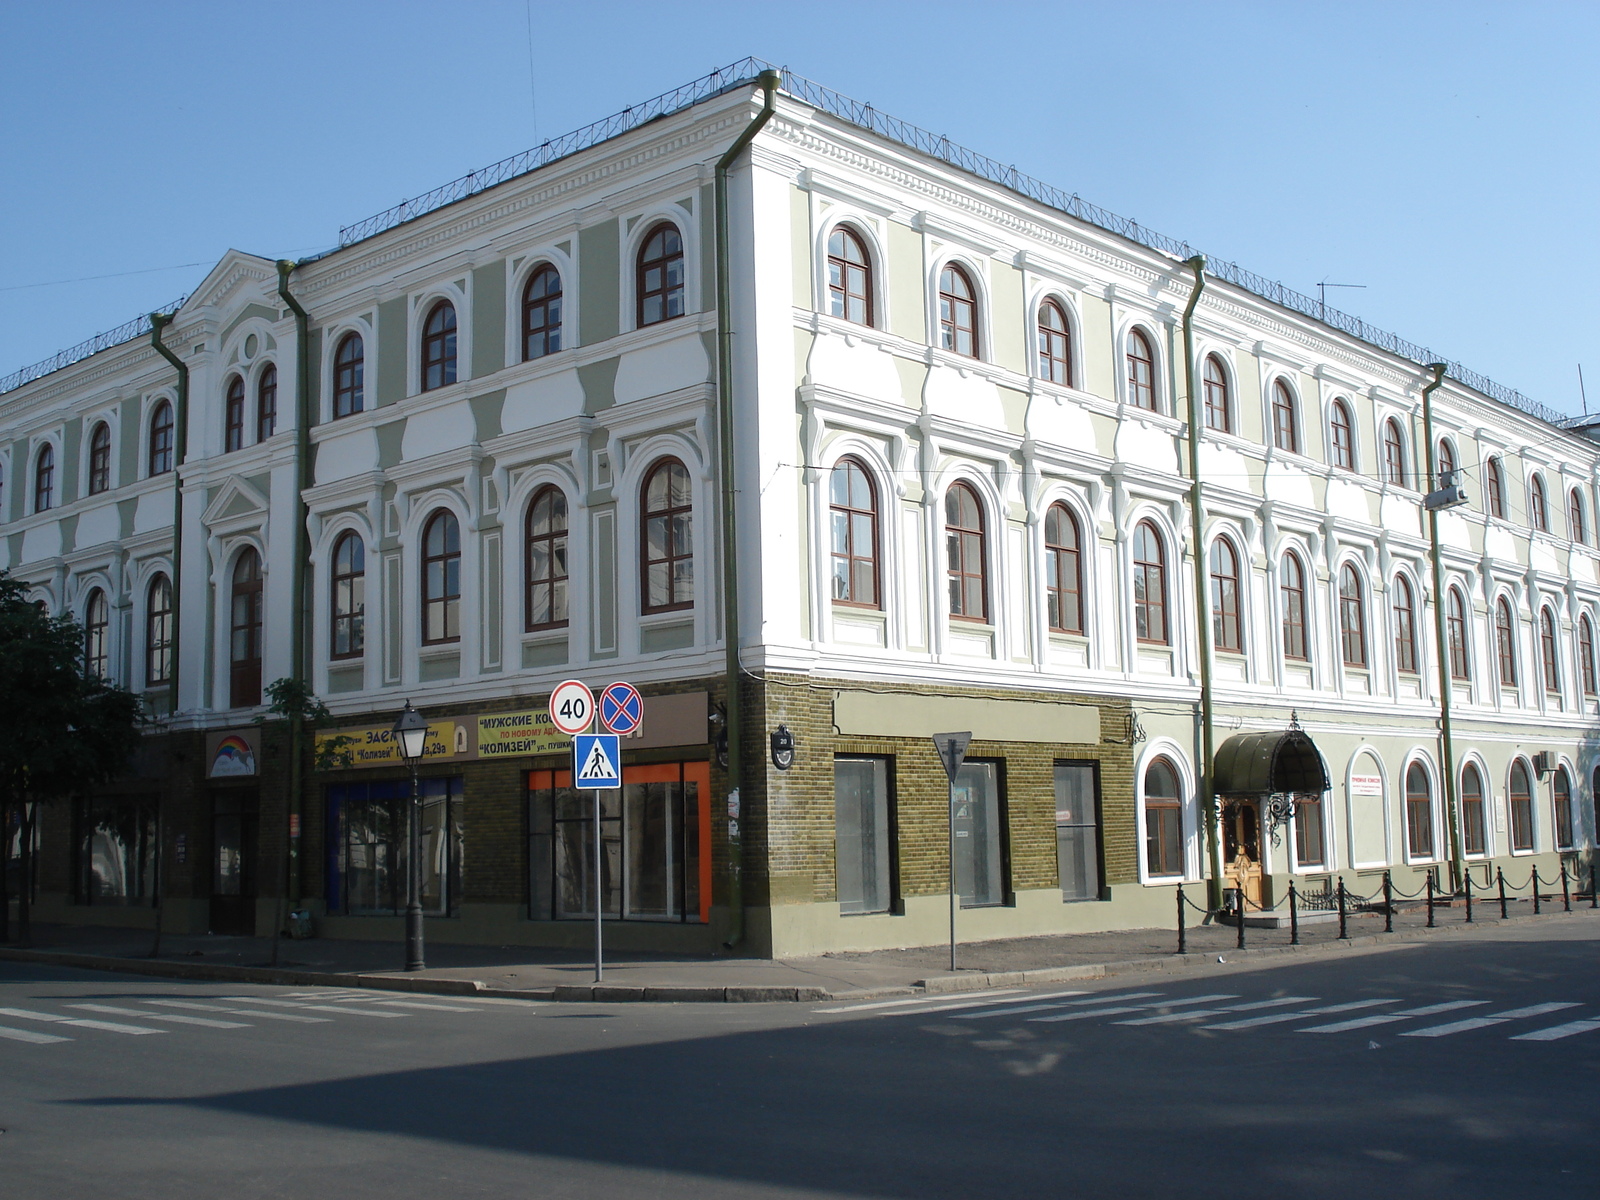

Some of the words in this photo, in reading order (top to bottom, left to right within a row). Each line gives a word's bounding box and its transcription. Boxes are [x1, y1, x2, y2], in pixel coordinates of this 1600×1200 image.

[559, 698, 585, 719] 40
[535, 713, 553, 724] КОС
[511, 728, 541, 738] НОВОМУ
[547, 741, 572, 750] ПУШКИ
